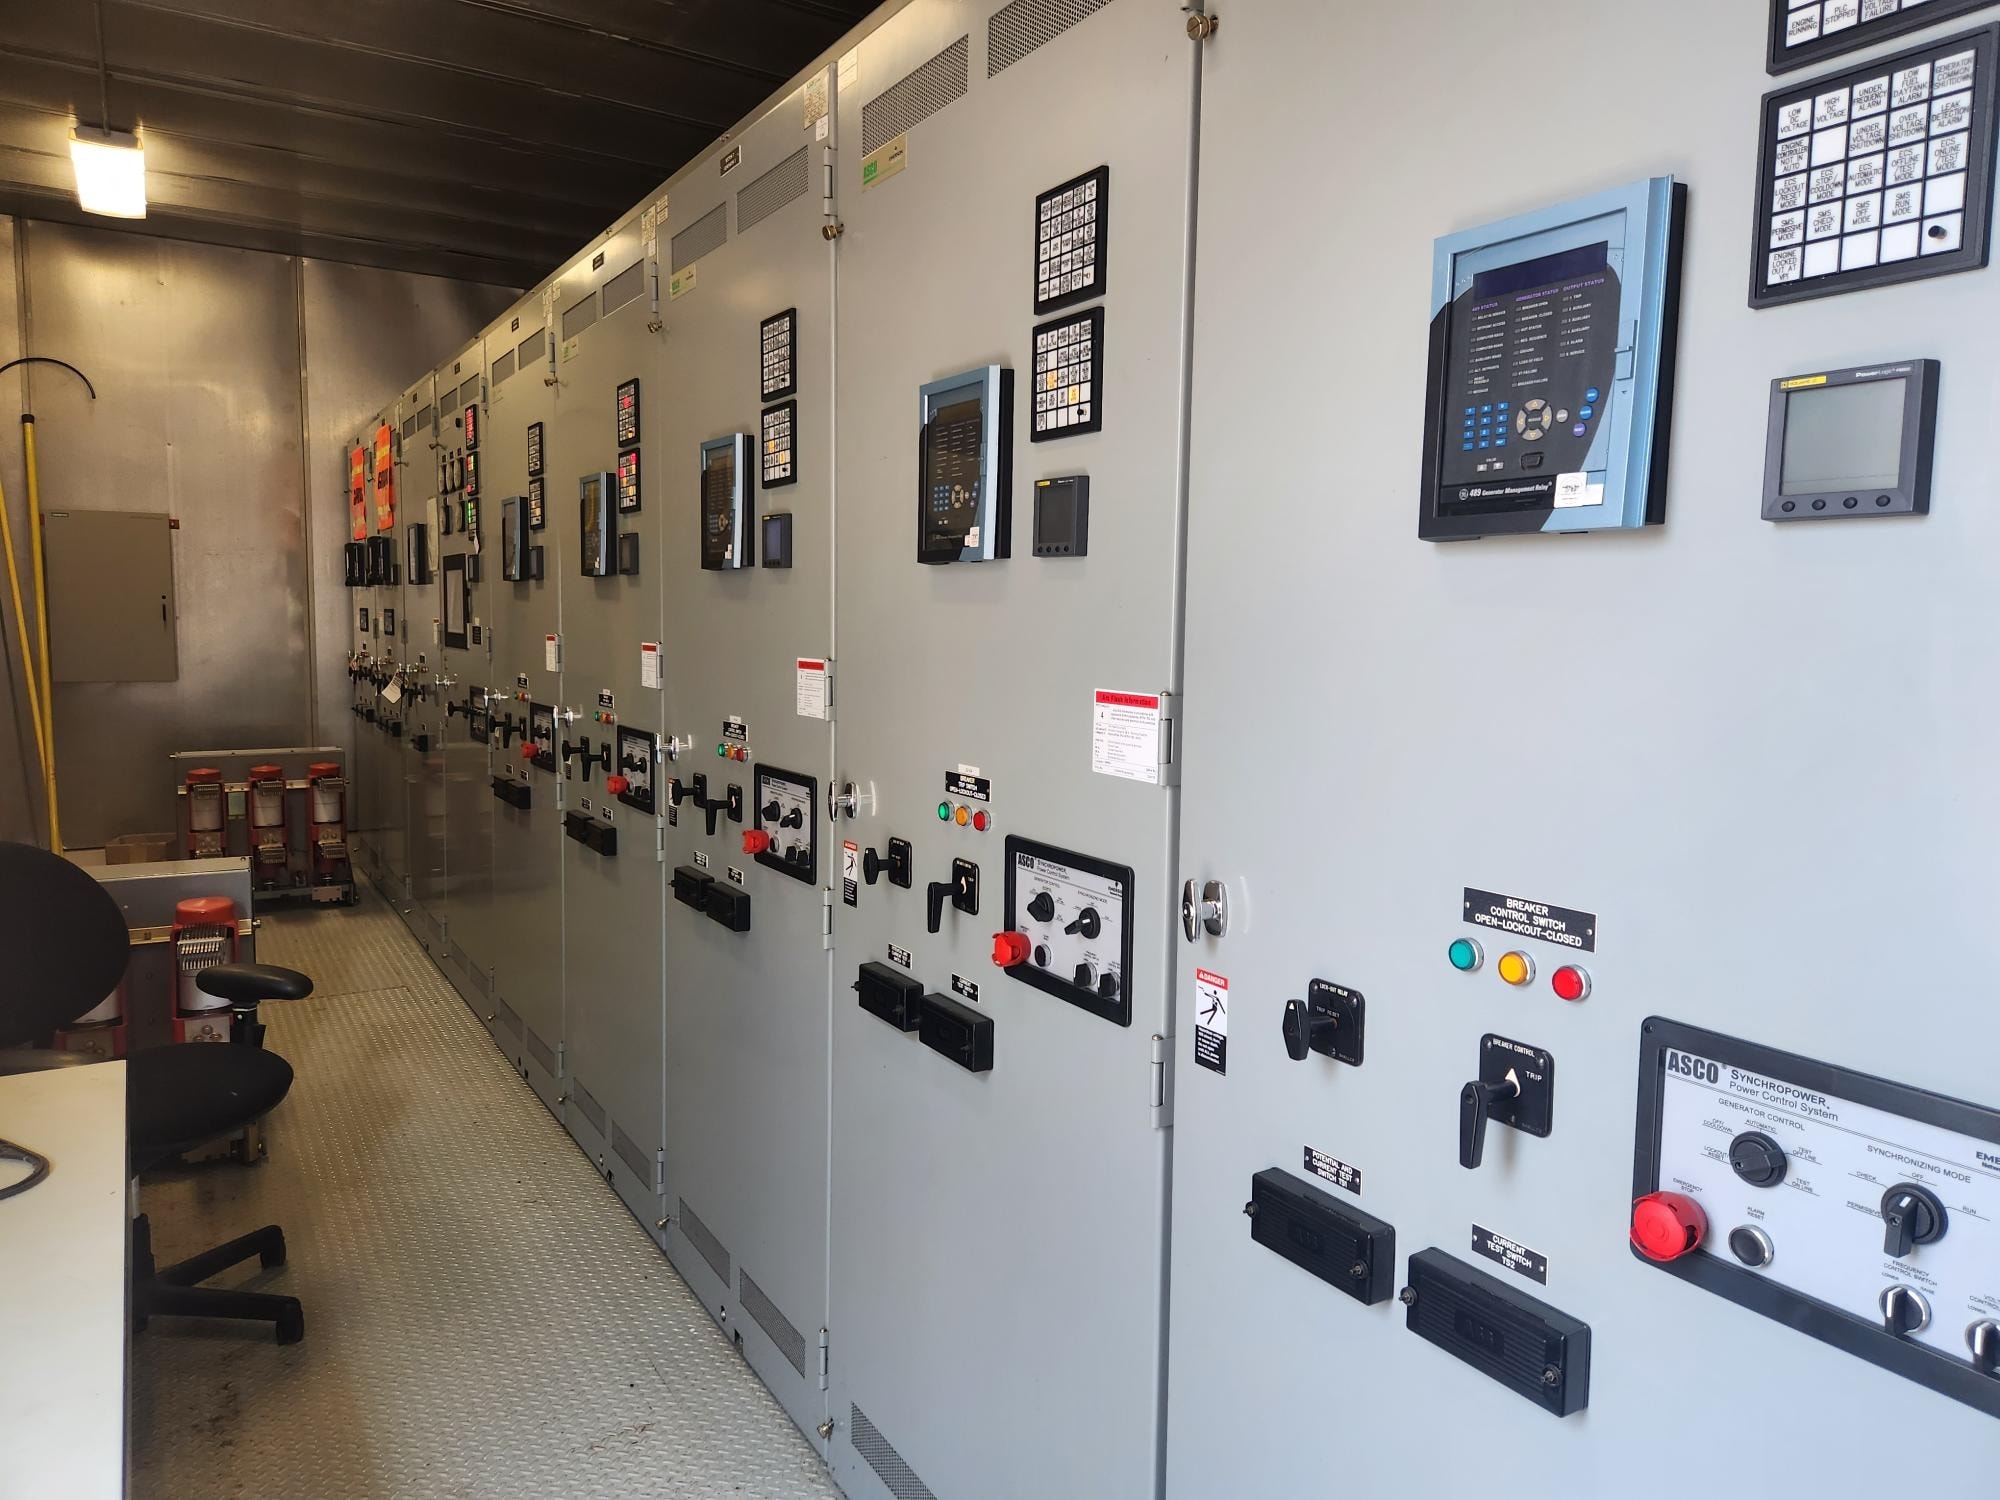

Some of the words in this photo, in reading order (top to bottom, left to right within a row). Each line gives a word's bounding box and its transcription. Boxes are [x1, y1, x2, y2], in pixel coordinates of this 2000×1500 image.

[1834, 5, 1848, 15] PLC
[1864, 4, 1893, 19] FAILURE
[1792, 15, 1816, 29] ENGINE
[1825, 9, 1856, 24] STOPPED
[1788, 23, 1818, 36] RUNNING
[1904, 69, 1919, 79] LOW
[1937, 67, 1970, 81] COMMON
[1902, 78, 1918, 88] FUEL
[1935, 74, 1972, 89] SHUTDOWN
[1858, 84, 1882, 96] UNDER
[1894, 82, 1928, 98] DAYTANK
[1824, 96, 1840, 105] HIGH
[1853, 90, 1886, 104] FREQUENCY
[1898, 92, 1922, 104] ALARM
[1826, 104, 1835, 113] DC
[1858, 100, 1882, 111] ALARM
[1941, 100, 1960, 111] LEAK
[1788, 108, 1801, 117] LOW
[1816, 109, 1846, 122] VOLTAGE
[1899, 112, 1918, 123] OVER
[1932, 105, 1968, 122] DETECTION
[1790, 115, 1799, 124] DC
[1892, 118, 1925, 133] VOLTAGE
[1938, 115, 1962, 128] ALARM
[1780, 120, 1808, 133] VOLTAGE
[1856, 123, 1879, 135] UNDER
[1853, 130, 1882, 143] VOLTAGE
[1889, 126, 1926, 140] SHUTDOWN
[1782, 140, 1804, 151] ENGINE
[1850, 137, 1885, 151] SHUTDOWN
[1941, 137, 1956, 147] ECS
[1777, 146, 1808, 159] CONTROLLER
[1899, 148, 1913, 158] ECS
[1935, 144, 1961, 156] ONLINE
[1780, 157, 1792, 166] NOT
[1892, 153, 1920, 167] OFFLINE
[1782, 163, 1800, 172] AUTO
[1821, 168, 1833, 177] ECS
[1859, 163, 1872, 172] ECS
[1936, 161, 1957, 172] MODE
[1848, 168, 1882, 180] AUTOMATIC
[1894, 170, 1914, 181] MODE
[1784, 178, 1796, 187] ECS
[1811, 181, 1842, 194] COOLDOWN
[1855, 177, 1873, 187] MODE
[1776, 183, 1804, 196] LOCKOUT
[1817, 190, 1834, 200] MODE
[1896, 192, 1911, 200] SMS
[1780, 199, 1797, 208] MODE
[1856, 201, 1870, 209] SMS
[1895, 200, 1910, 208] RUN
[1817, 210, 1832, 218] SMS
[1856, 208, 1869, 217] OFF
[1892, 206, 1912, 216] MODE
[1781, 218, 1794, 226] SMS
[1813, 216, 1835, 226] CHECK
[1852, 216, 1871, 225] MODE
[1772, 223, 1802, 235] PERMISSIVE
[1814, 224, 1832, 233] MODE
[1778, 232, 1795, 240] MODE
[1774, 250, 1796, 260] ENGINE
[1772, 258, 1797, 268] LOCKED
[1772, 267, 1784, 275] OUT
[1563, 282, 1582, 291] OUTPUT
[1470, 489, 1481, 497] 489
[1535, 483, 1548, 491] Relay
[1018, 854, 1034, 869] ASCO
[1507, 898, 1548, 916] BREAKER
[1490, 906, 1529, 923] CONTROL
[1533, 916, 1565, 931] SWITCH
[1475, 913, 1582, 947] OPEN-LOCKOUT-CLOSED
[1203, 973, 1224, 986] DANGER
[1514, 1045, 1535, 1057] CONTROL
[1667, 1051, 1719, 1084] ASCO
[1525, 1070, 1542, 1082] TRIP
[1729, 1081, 1758, 1097] Power
[1762, 1091, 1797, 1109] Control
[1800, 1102, 1838, 1122] System
[1718, 1098, 1765, 1119] GENERATOR
[1767, 1113, 1805, 1131] CONTROL
[1746, 1119, 1776, 1132] AUTOMATIC
[1313, 1151, 1340, 1169] POTENTIAL
[1341, 1164, 1352, 1174] AND
[1867, 1145, 1941, 1173] SYNCHRONIZING
[1943, 1169, 1971, 1183] MODE
[1312, 1159, 1338, 1175] CURRENT
[1339, 1170, 1352, 1182] TEST
[1318, 1168, 1337, 1182] SWITCH
[1856, 1171, 1876, 1181] CHECK
[1673, 1178, 1703, 1192] EMERGENCY
[1747, 1206, 1764, 1216] ALARM
[1747, 1212, 1764, 1220] RESET
[1963, 1205, 1976, 1215] RUN
[1493, 1235, 1526, 1256] CURRENT
[1487, 1240, 1504, 1254] TEST
[1506, 1250, 1532, 1268] SWITCH
[1502, 1256, 1515, 1269] TS2
[1892, 1260, 1929, 1277] FREQUENCY
[1884, 1263, 1912, 1277] CONTROL
[1914, 1274, 1937, 1287] SWITCH
